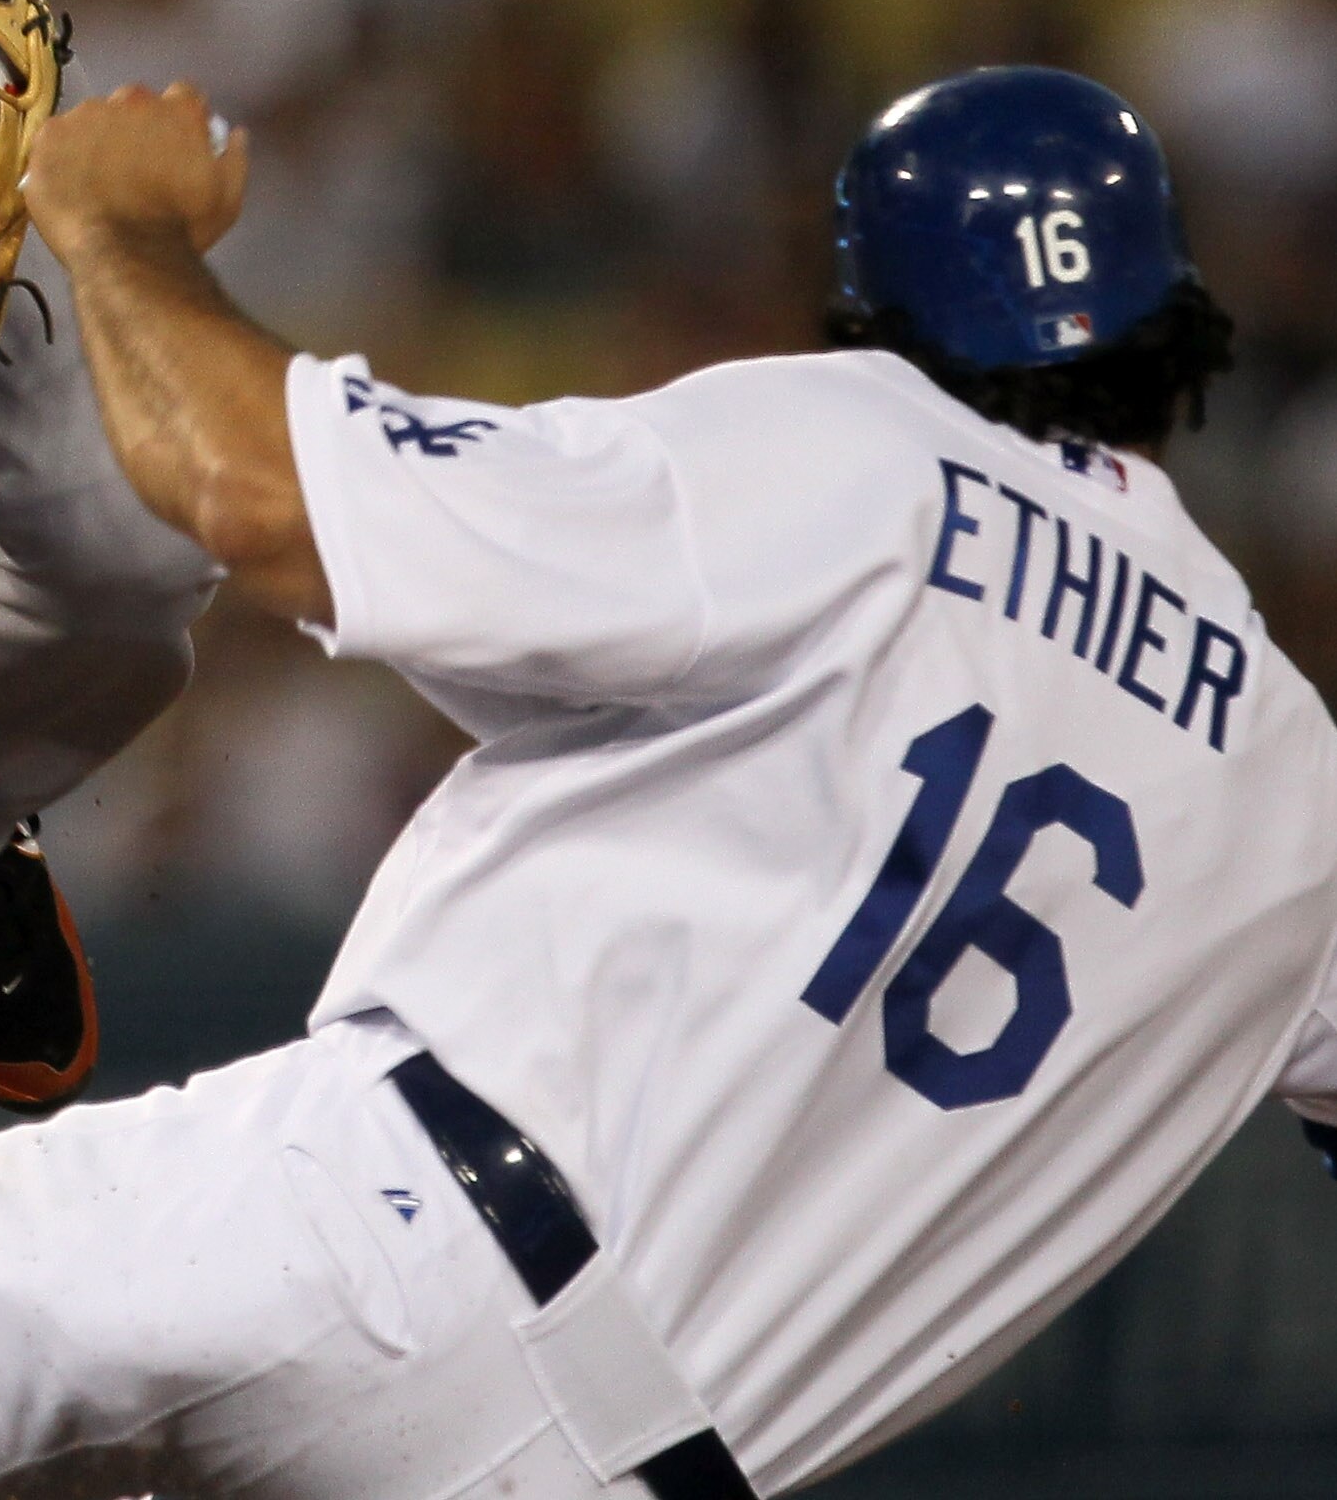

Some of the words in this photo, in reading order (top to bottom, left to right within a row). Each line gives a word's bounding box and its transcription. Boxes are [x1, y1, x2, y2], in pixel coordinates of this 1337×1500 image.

[1016, 209, 1091, 288] 16
[926, 457, 1249, 754] ETHIER
[799, 703, 1145, 1112] 16
